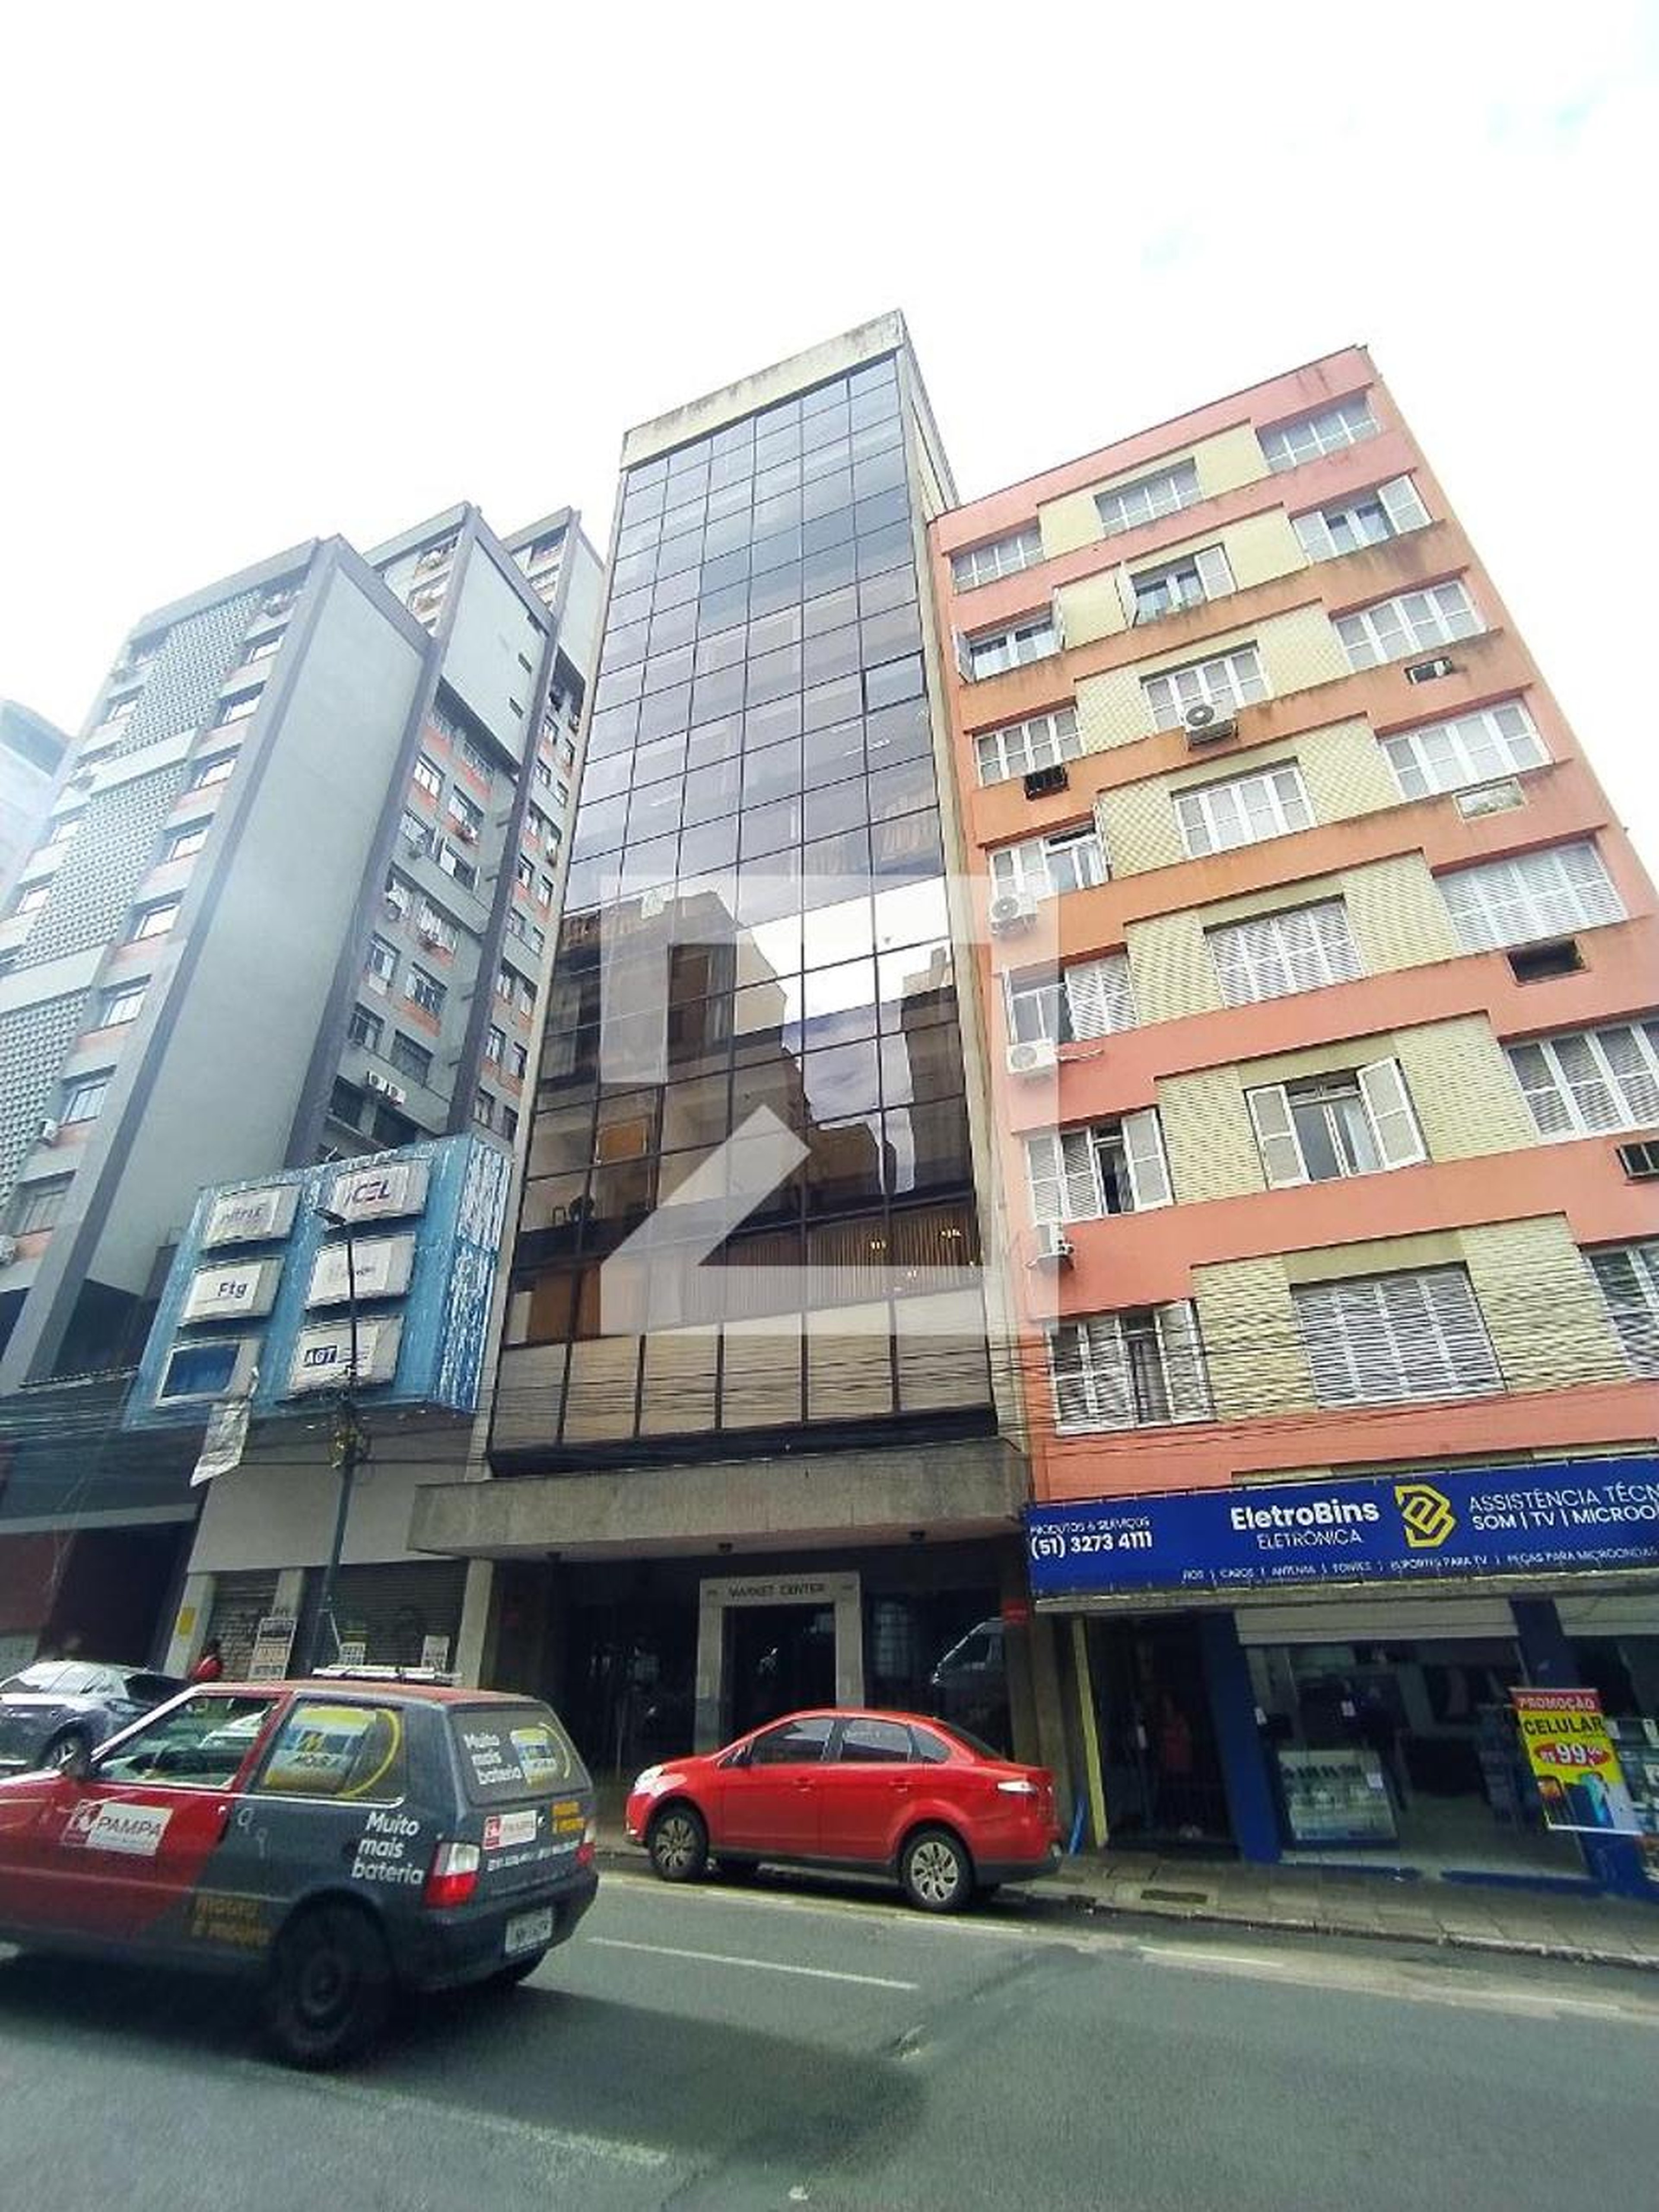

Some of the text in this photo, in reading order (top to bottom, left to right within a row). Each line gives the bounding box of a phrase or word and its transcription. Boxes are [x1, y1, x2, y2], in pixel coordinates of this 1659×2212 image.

[1470, 1488, 1601, 1512] ASSISTÊNCIA
[1231, 1498, 1380, 1531] EletroBins
[1472, 1503, 1659, 1531] SOM TV MICROO
[1031, 1531, 1153, 1560] (51) 3273 4111
[1518, 1696, 1595, 1711] PROMOÇÃO
[1524, 1715, 1606, 1735] CELULAR
[463, 1732, 500, 1749] Muito
[471, 1749, 502, 1766] mais
[477, 1764, 523, 1785] bateria
[96, 1816, 161, 1835] PAMPA
[365, 1811, 420, 1836] Muito
[358, 1837, 404, 1858] mais
[351, 1857, 425, 1884] bateria
